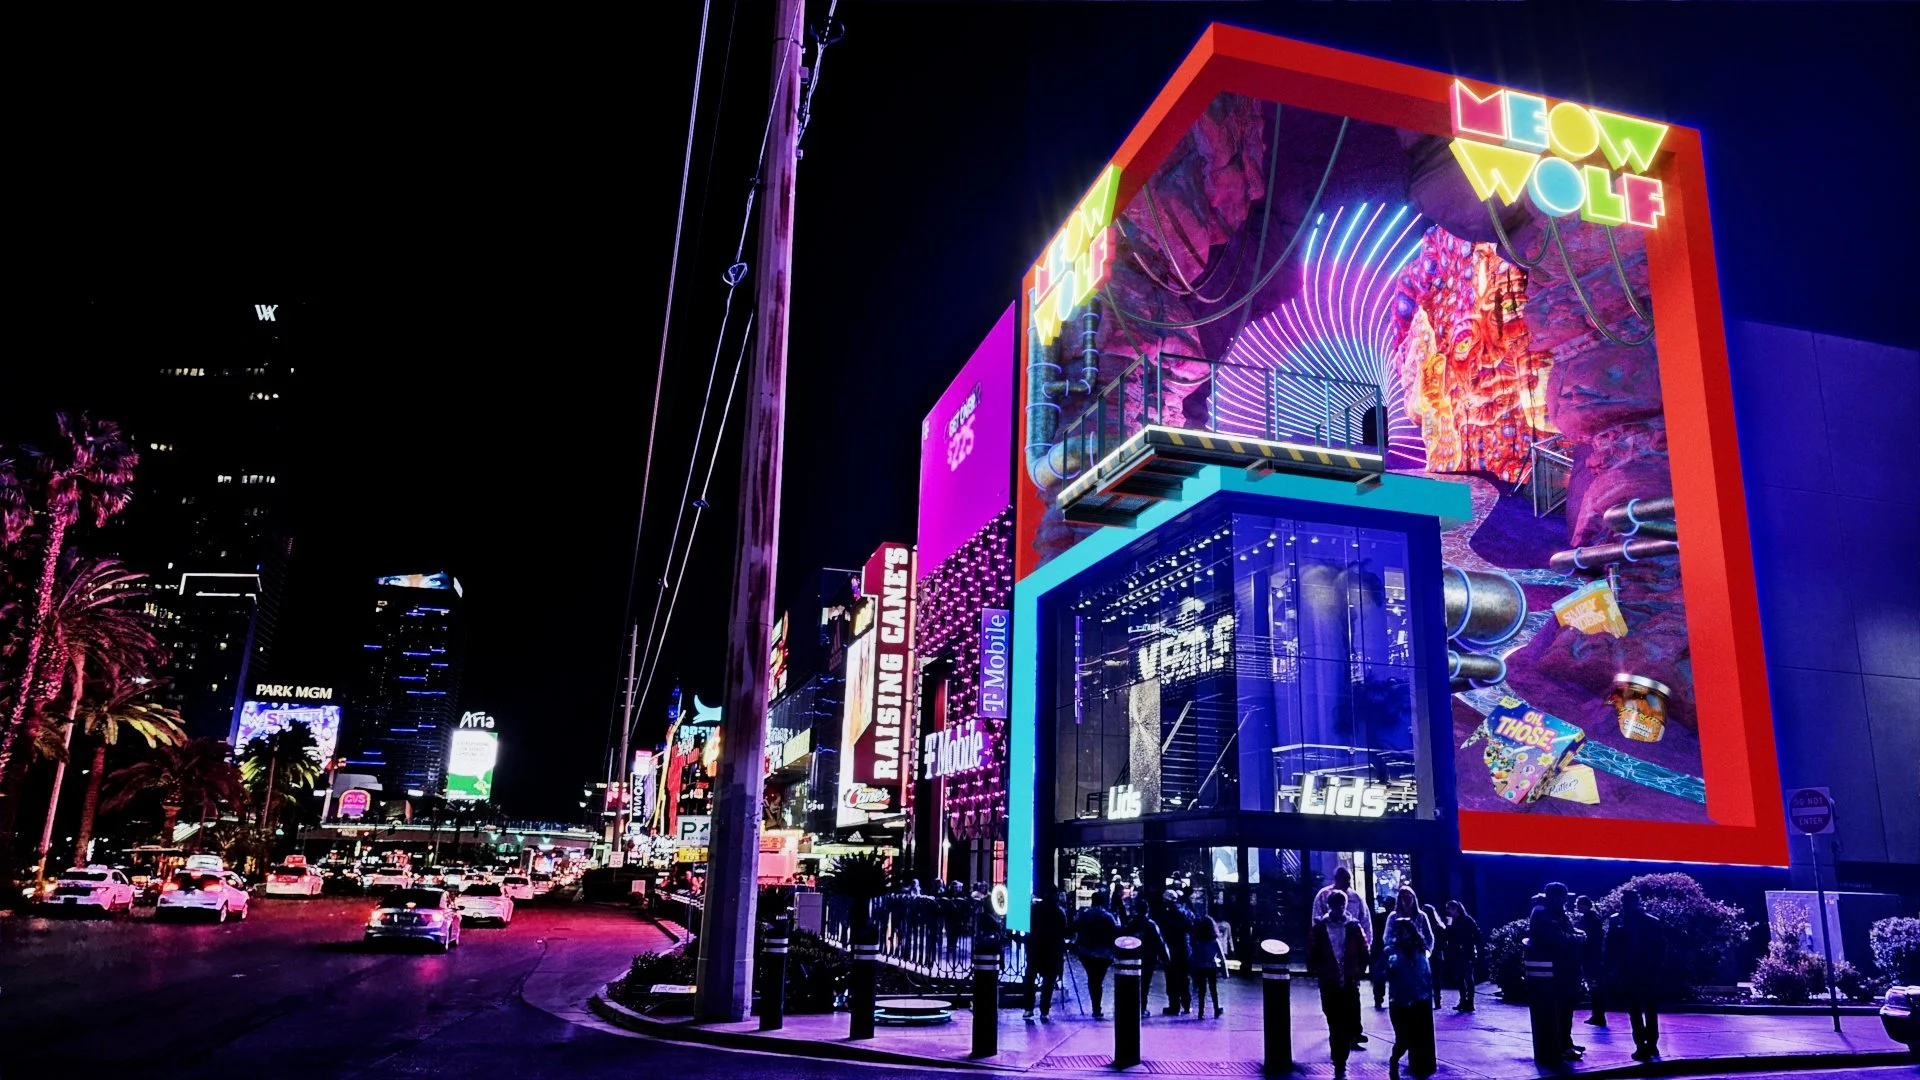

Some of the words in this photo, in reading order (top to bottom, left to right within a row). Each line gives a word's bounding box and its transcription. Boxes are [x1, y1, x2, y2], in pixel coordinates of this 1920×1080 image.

[1450, 78, 1669, 175] MEOW
[1449, 137, 1666, 230] WOLF
[1034, 163, 1121, 305] MEOW
[1034, 226, 1116, 346] WOLF
[880, 547, 909, 644] CANE'S
[255, 684, 294, 697] PARK
[295, 686, 333, 700] MGM
[459, 711, 495, 729] Aria
[873, 653, 905, 780] RAISING
[344, 793, 367, 804] CVS
[1107, 783, 1142, 820] Lids
[1300, 773, 1388, 818] Lids
[1807, 797, 1823, 805] NOT
[1798, 817, 1824, 826] ENTER
